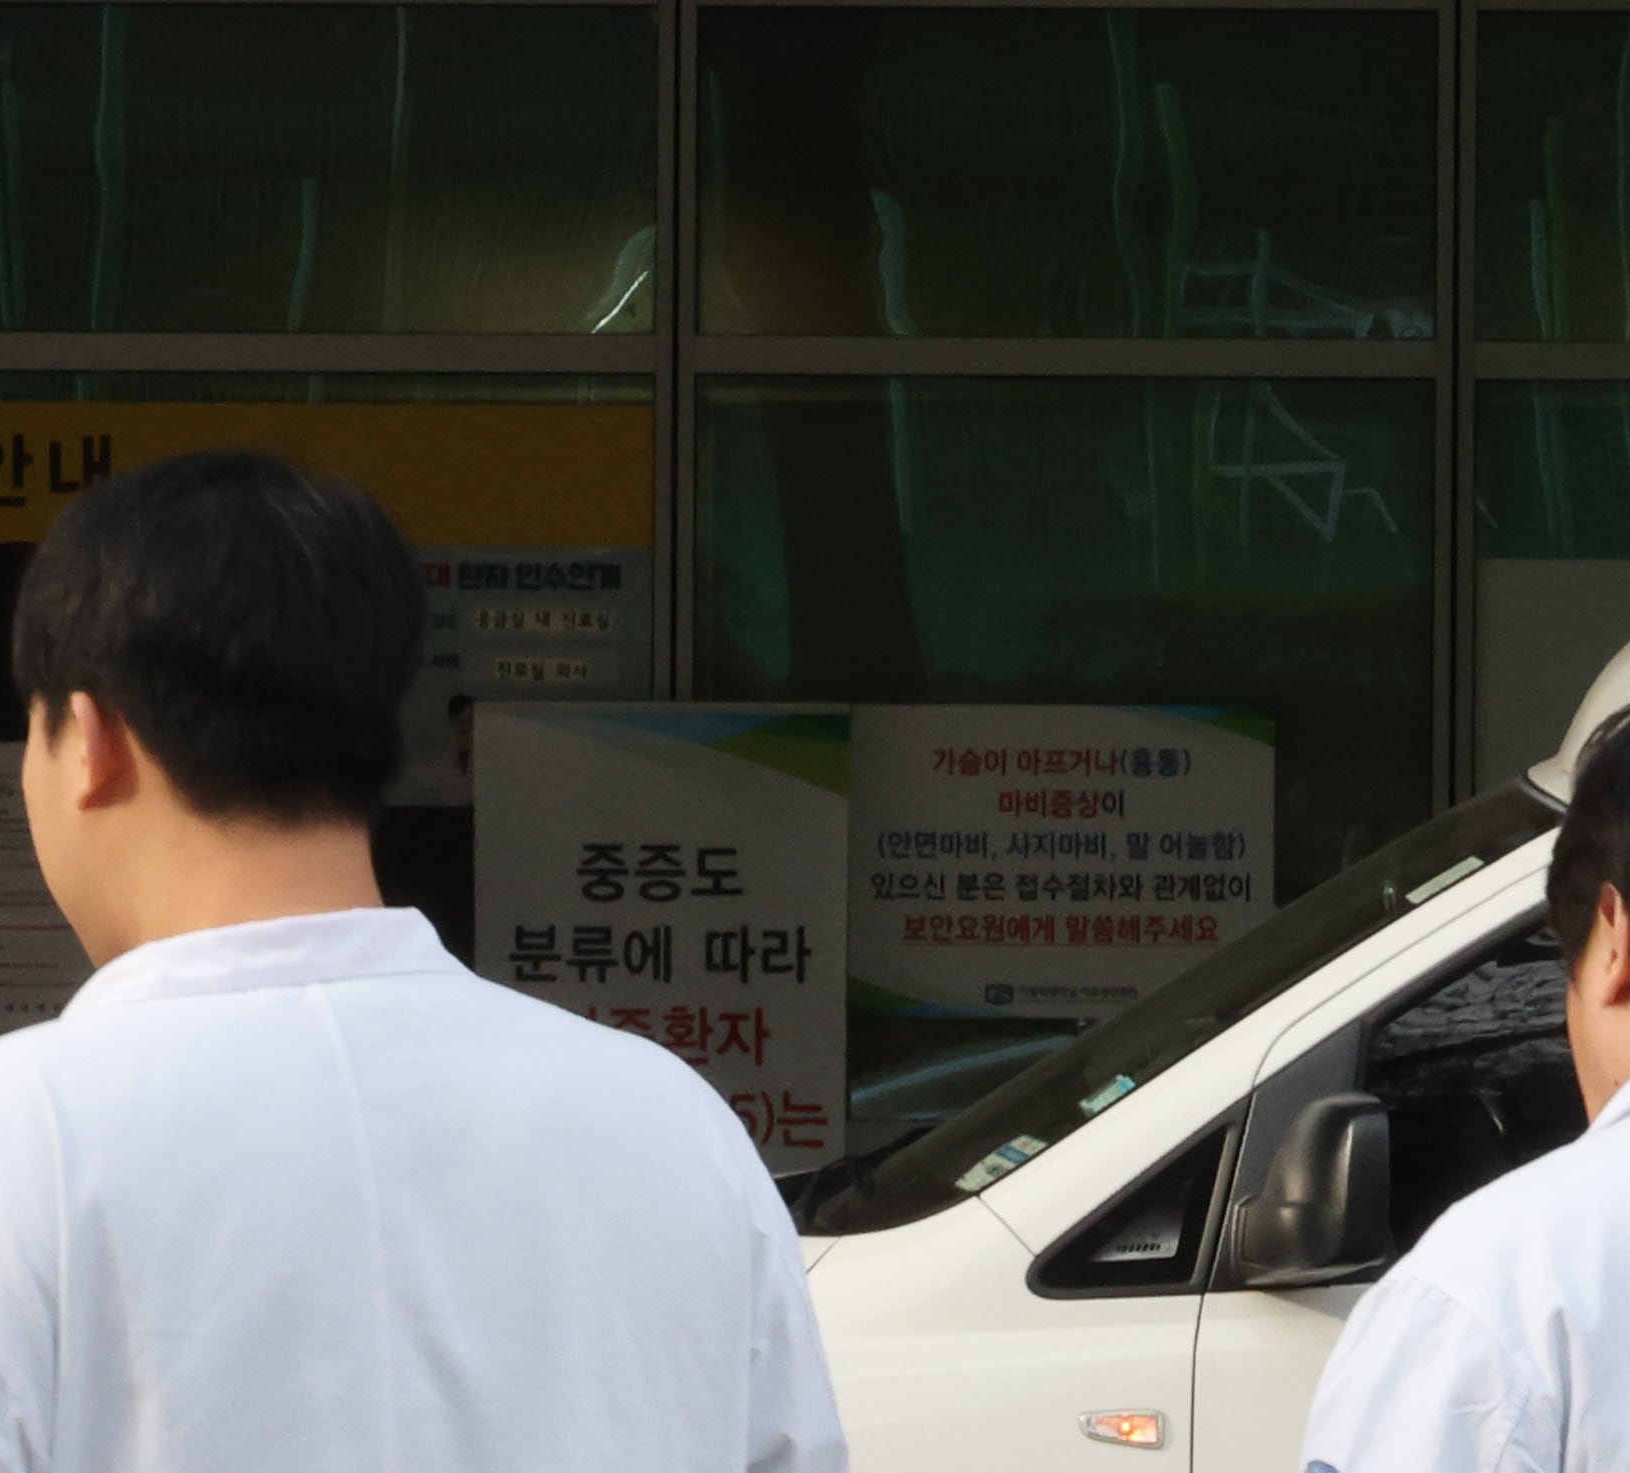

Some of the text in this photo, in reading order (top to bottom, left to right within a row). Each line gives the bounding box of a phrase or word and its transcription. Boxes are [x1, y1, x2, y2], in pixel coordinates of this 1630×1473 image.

[932, 749, 1006, 776] 가슴이
[998, 790, 1124, 819] 마비증상이
[878, 831, 1245, 860] (안면마비, 사지마비, 말 어눌함)
[577, 843, 744, 902] 중증도
[870, 873, 1251, 902] 있으신 분은 접수절차와 관계없이
[903, 914, 1218, 944] 보안요원에게 말씀해주세요
[508, 924, 811, 984] 분류에 따라
[584, 1007, 771, 1066] 환자
